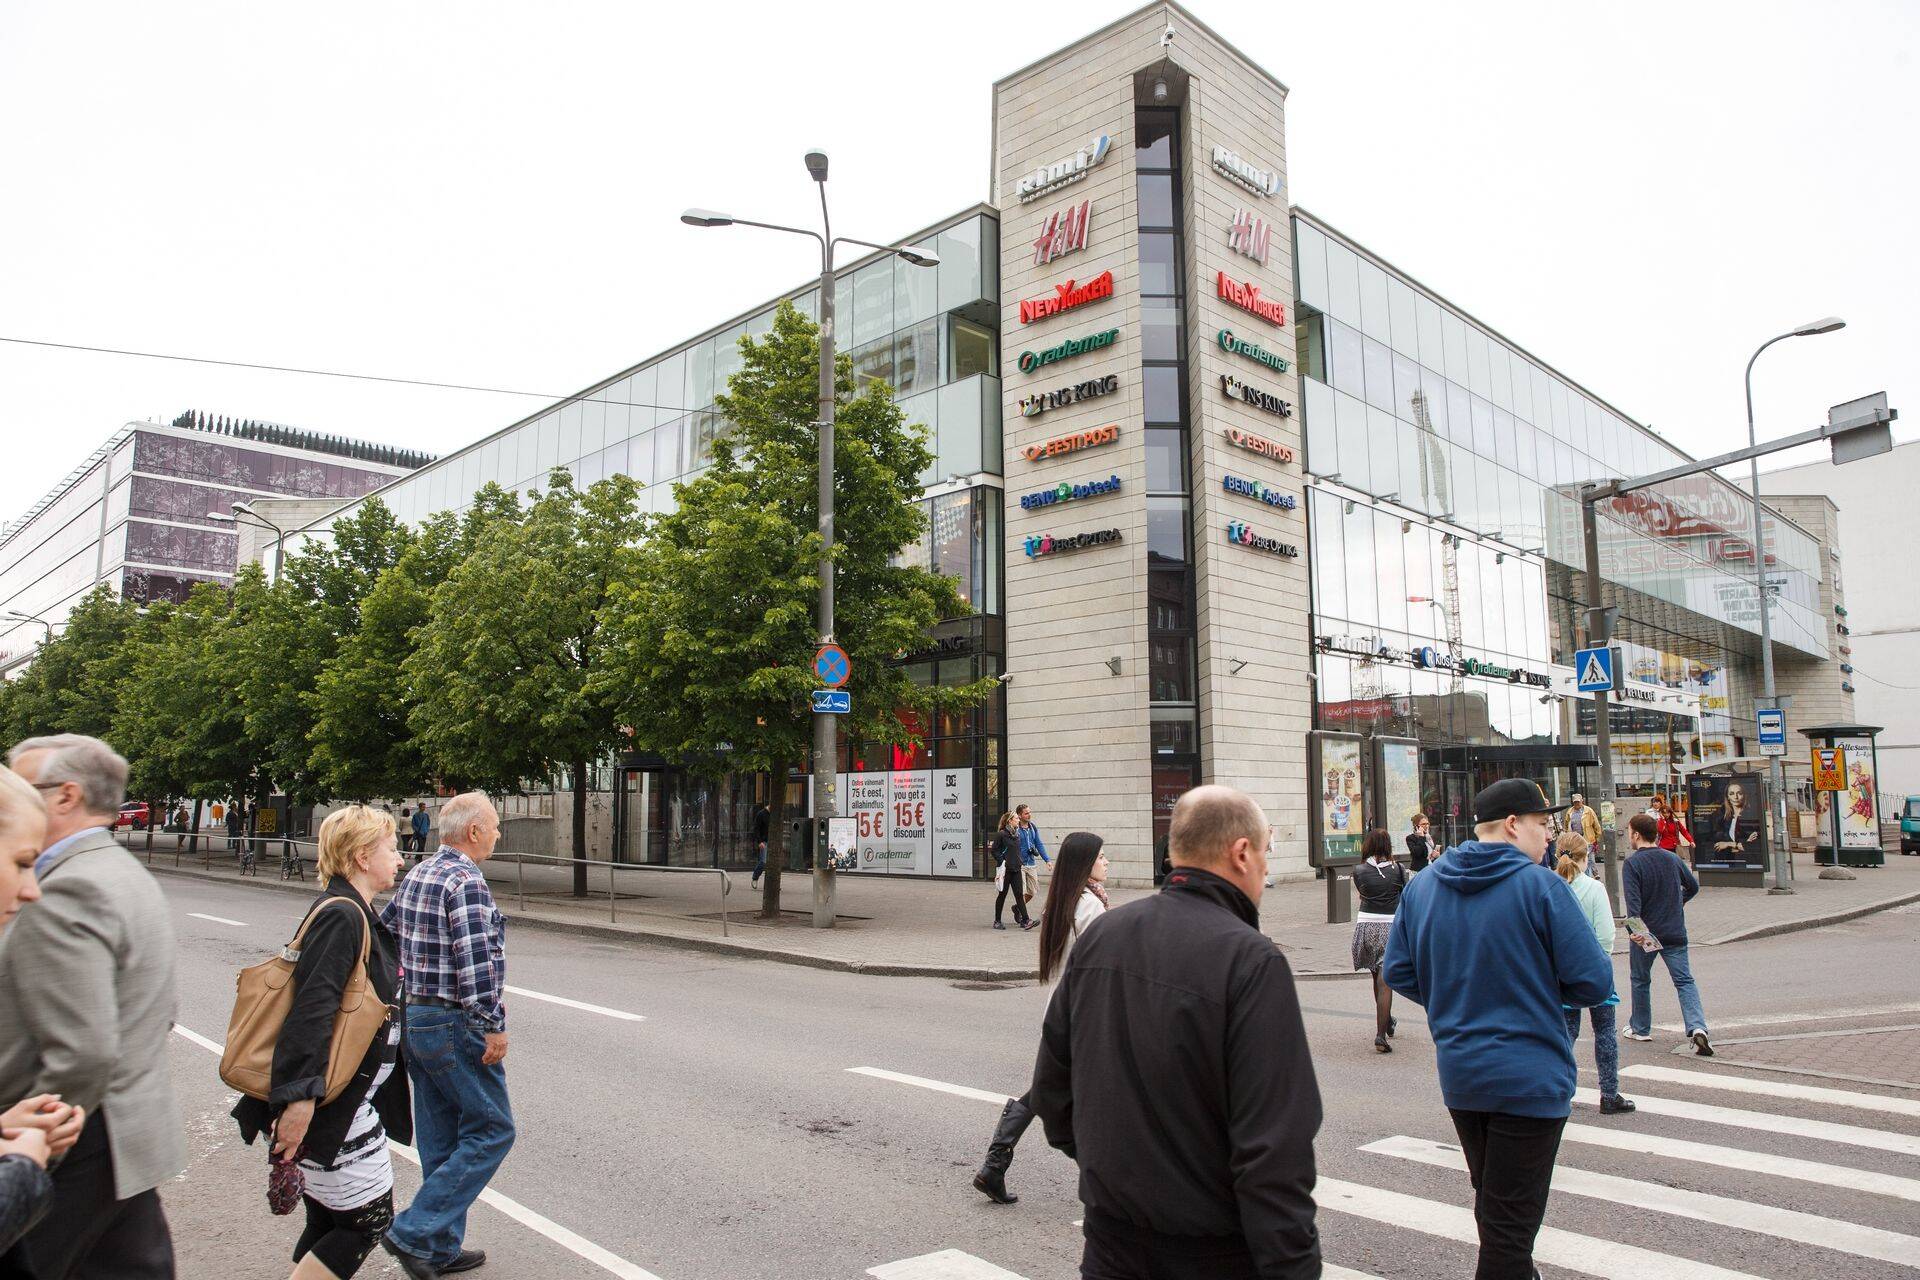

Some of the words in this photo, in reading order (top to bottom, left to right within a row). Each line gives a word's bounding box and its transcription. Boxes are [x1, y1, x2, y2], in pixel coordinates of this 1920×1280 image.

[1033, 200, 1092, 265] H&M
[1074, 373, 1119, 402] KING
[1263, 393, 1292, 418] KING
[1046, 434, 1082, 457] EESTI
[1084, 424, 1120, 446] POST
[1246, 434, 1274, 456] EESTI
[1274, 444, 1297, 463] POST
[1021, 490, 1058, 510] BENU
[1072, 475, 1121, 498] Apteek
[1224, 475, 1254, 496] BENU
[1051, 537, 1076, 551] PERE
[1252, 534, 1270, 549] PERE
[867, 788, 884, 799] eest,
[893, 791, 907, 802] you
[908, 789, 919, 801] get
[921, 792, 926, 800] a
[942, 811, 962, 820] ecco
[893, 827, 925, 839] discount
[875, 849, 912, 860] rademar
